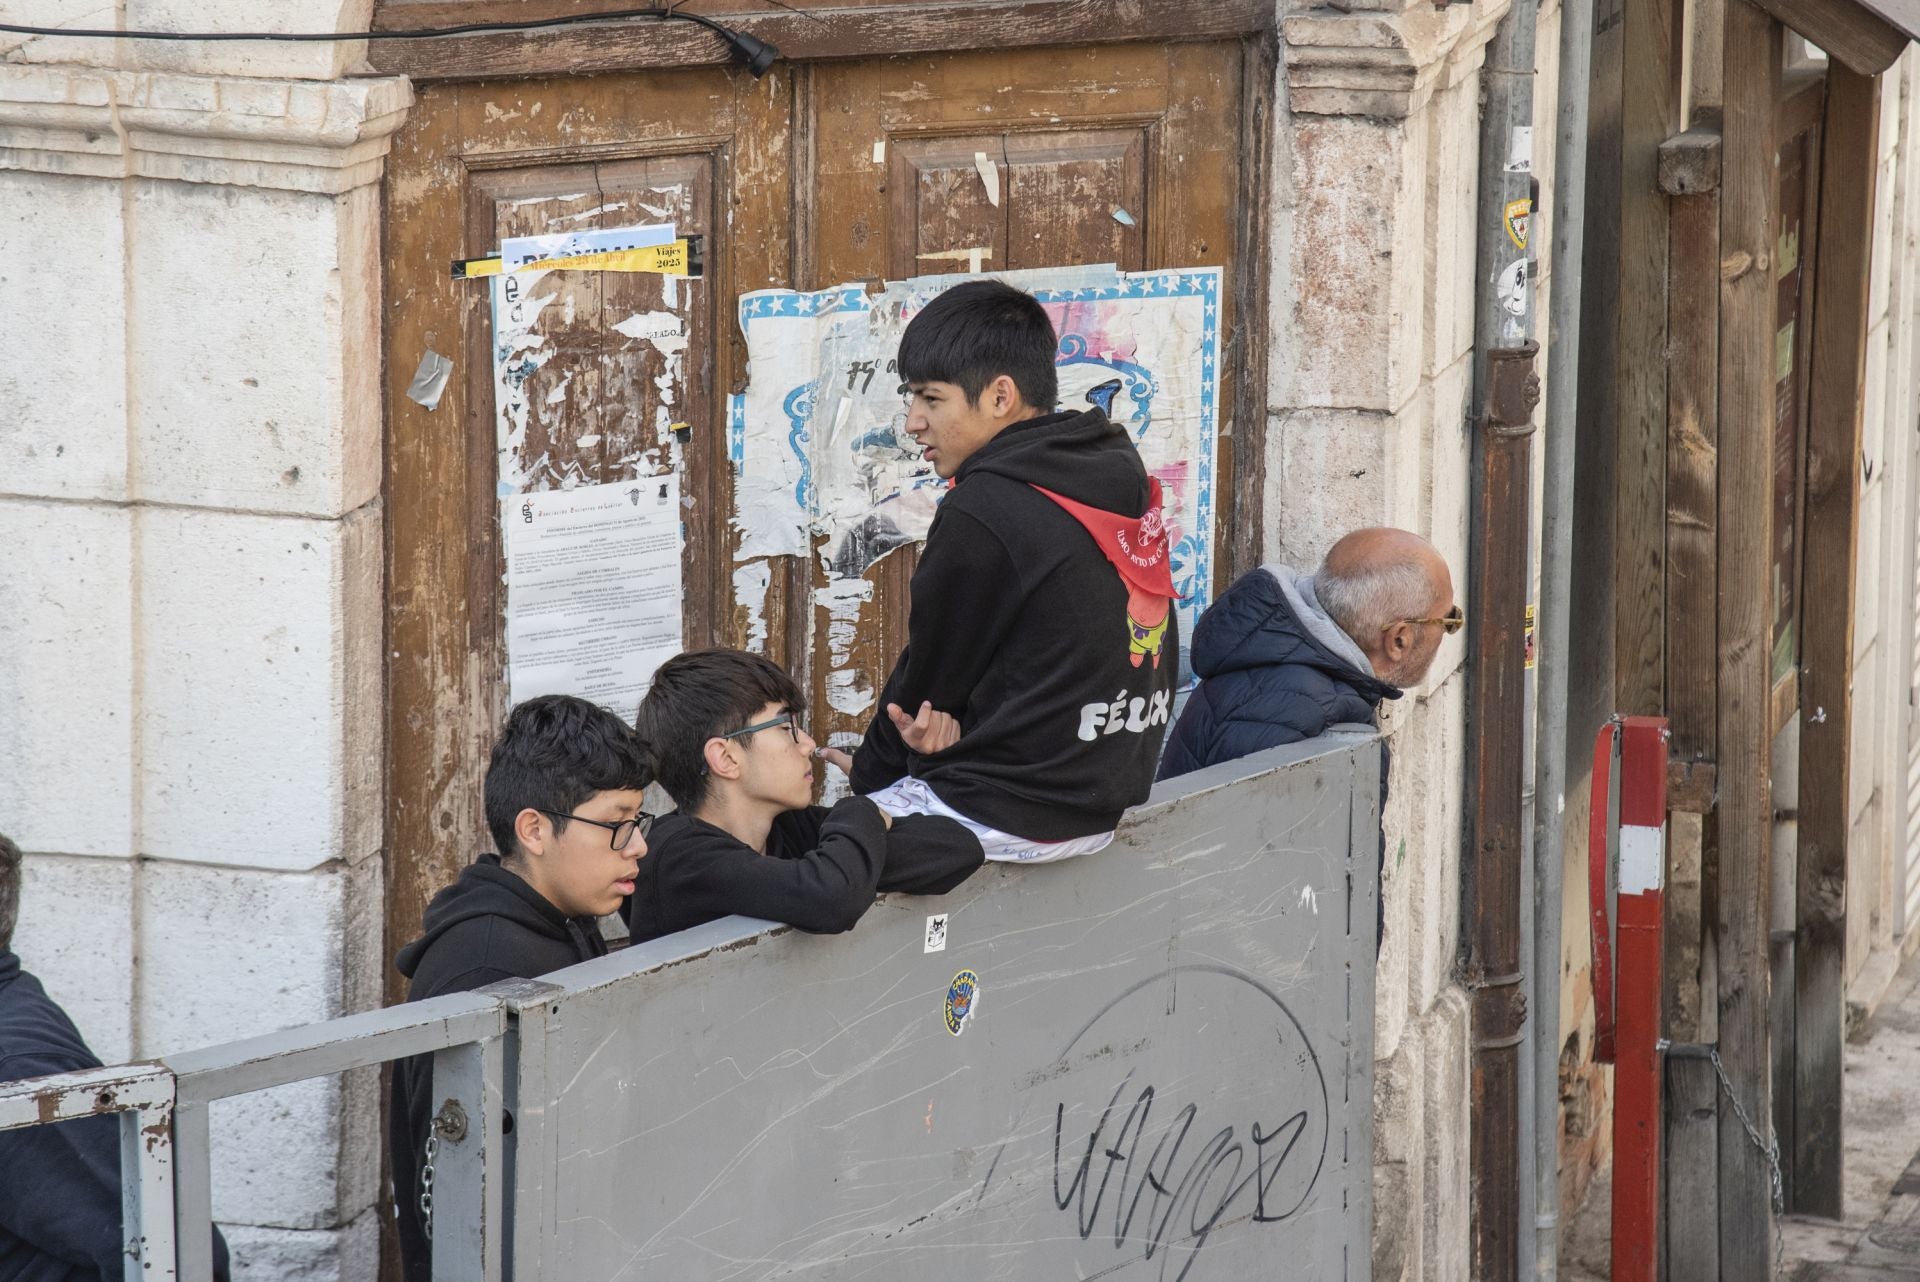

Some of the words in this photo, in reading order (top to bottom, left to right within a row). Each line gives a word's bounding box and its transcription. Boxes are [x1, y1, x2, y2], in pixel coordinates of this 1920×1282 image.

[656, 247, 681, 258] Viajes
[1148, 554, 1158, 567] DE
[1077, 688, 1170, 742] FÉLIX
